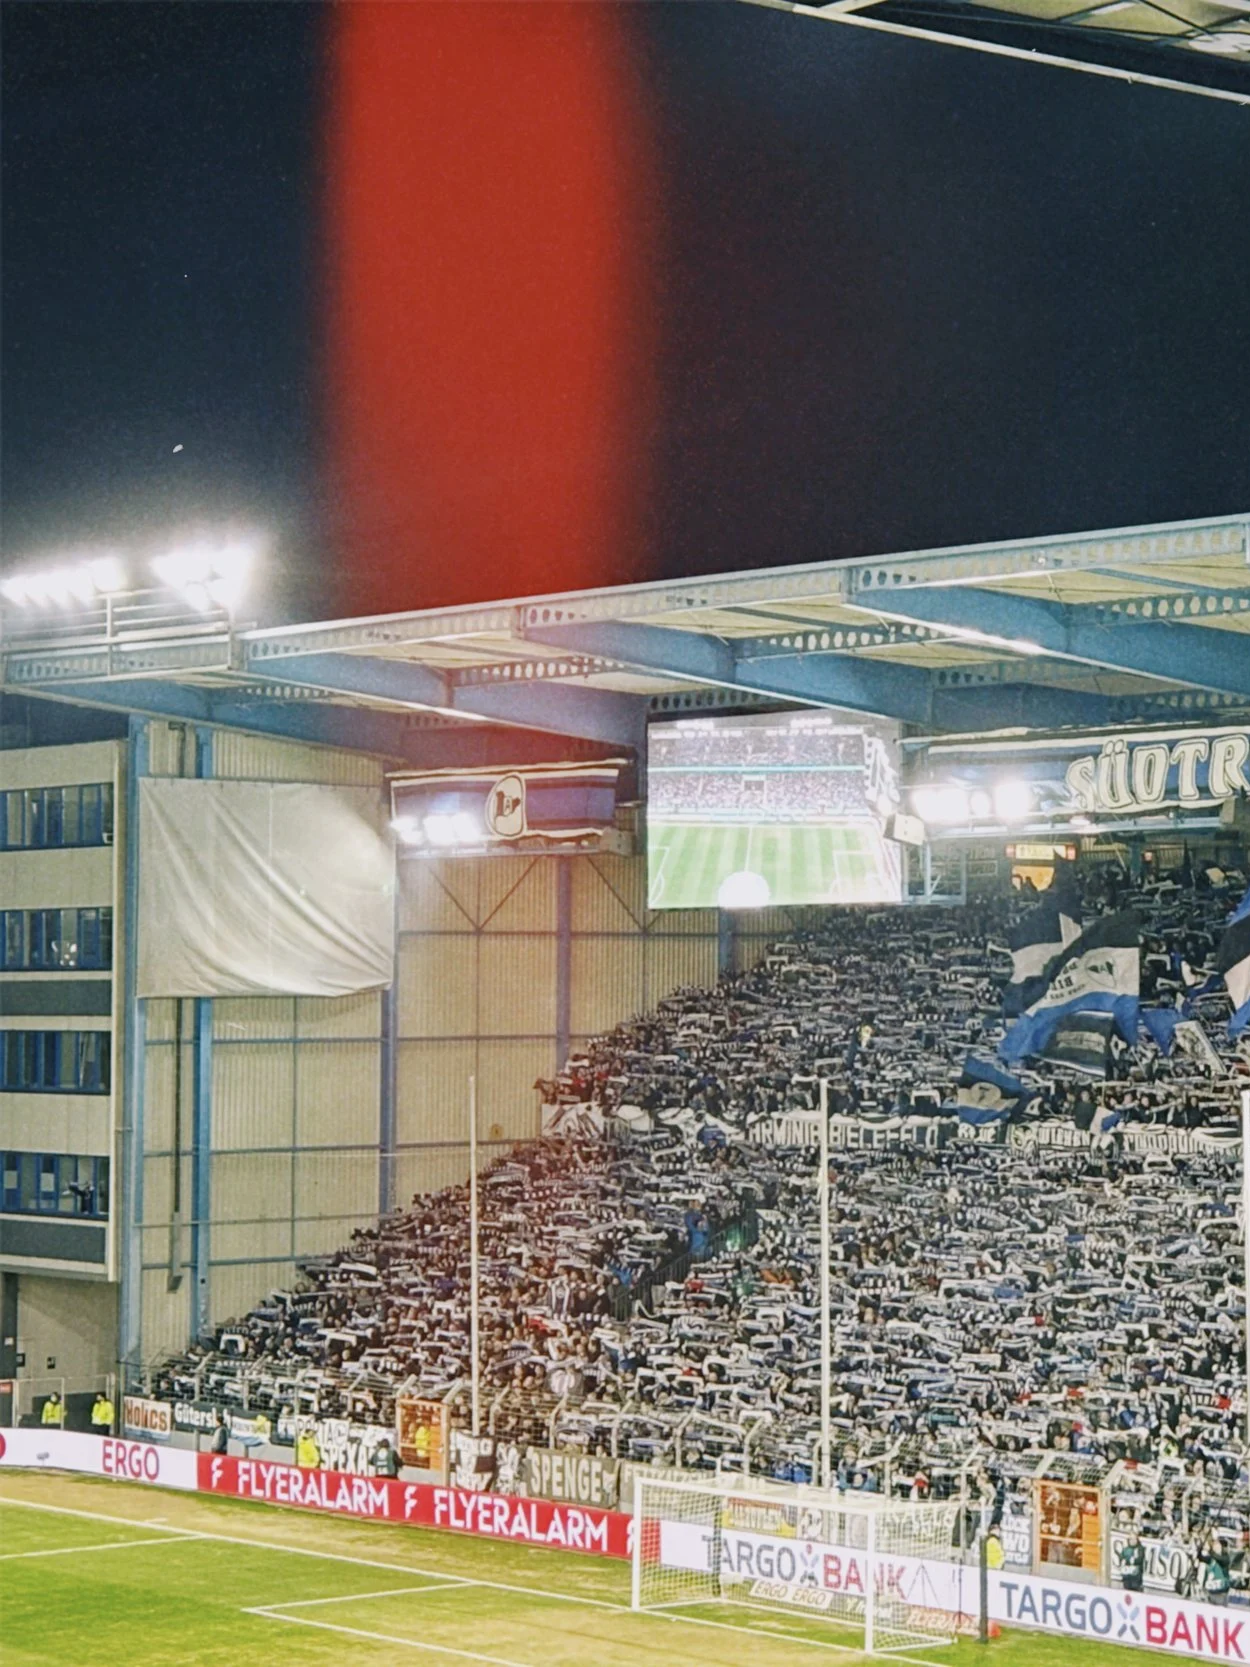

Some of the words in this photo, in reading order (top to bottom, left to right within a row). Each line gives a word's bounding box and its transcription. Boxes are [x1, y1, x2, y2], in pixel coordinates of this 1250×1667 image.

[102, 1439, 160, 1480] ERGO
[530, 1452, 601, 1501] SPENGE
[237, 1460, 389, 1517] FLYERALARM
[433, 1489, 608, 1552] FLYERALARM
[753, 1581, 788, 1599] ERGO
[792, 1590, 828, 1607] ERGO
[1000, 1582, 1112, 1635] TARGO
[1146, 1606, 1246, 1660] BANK
